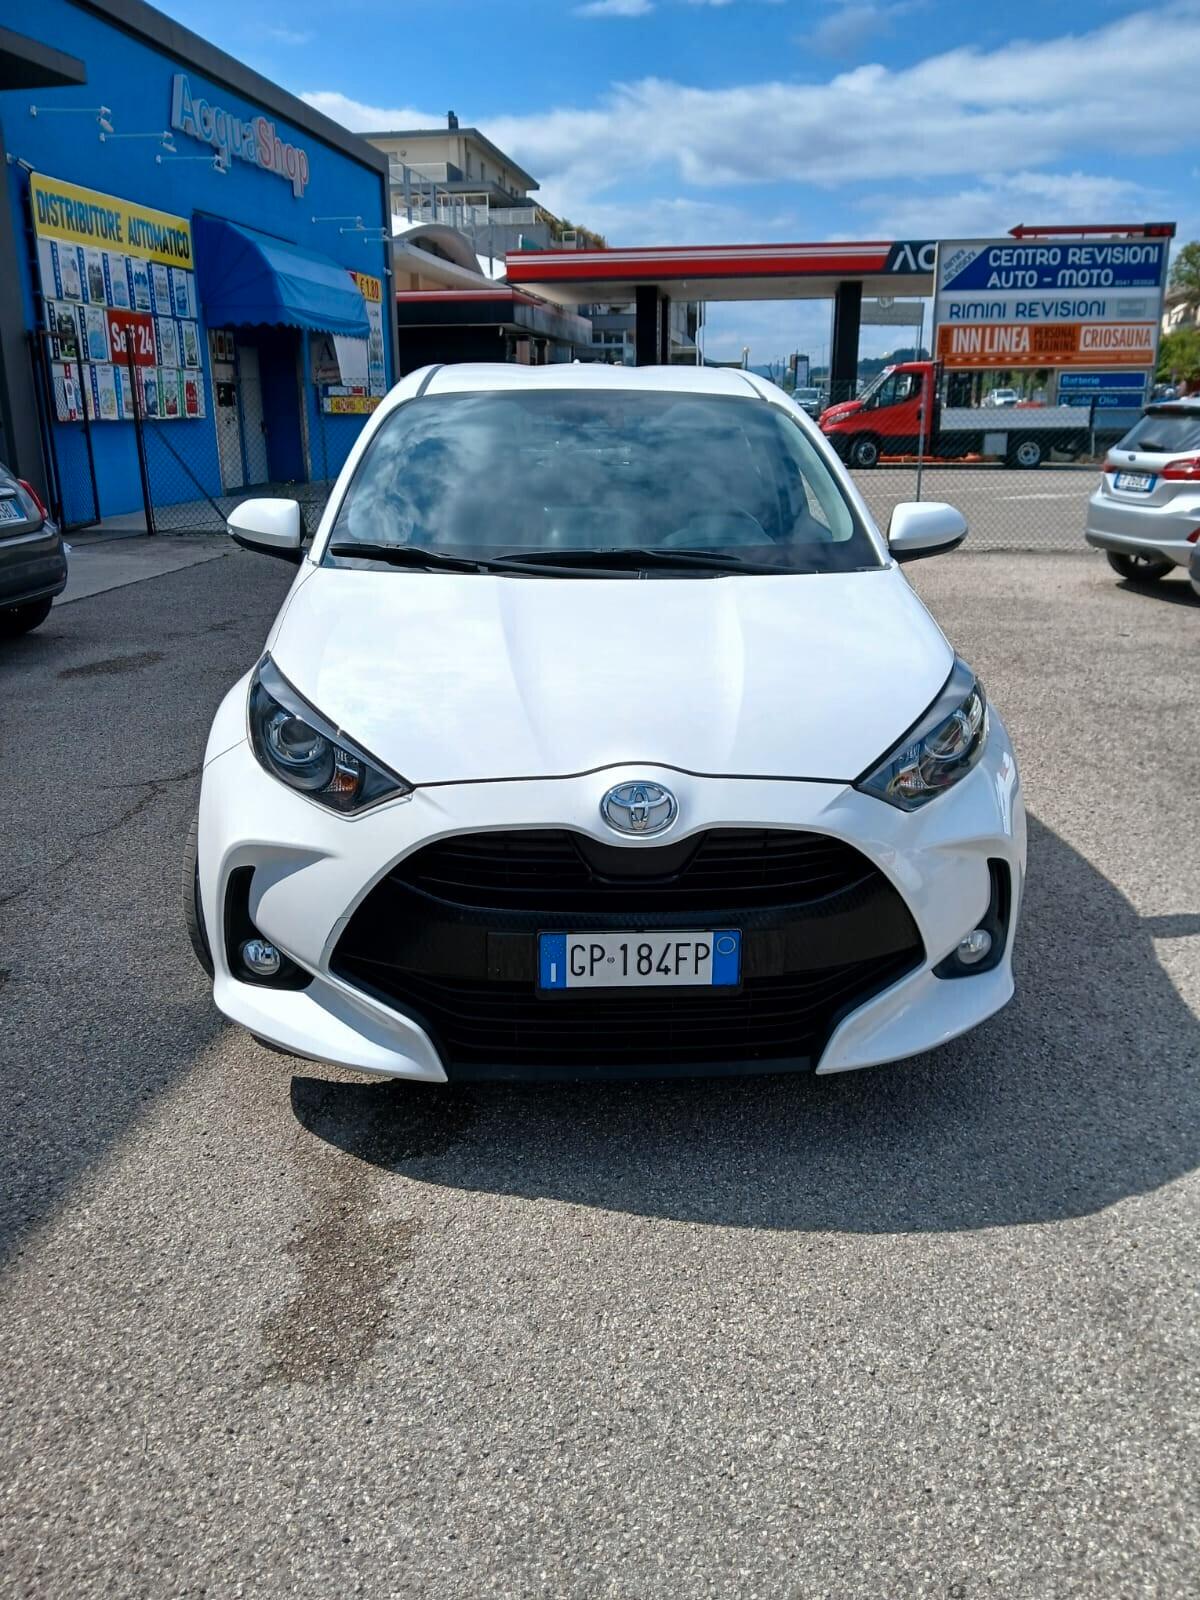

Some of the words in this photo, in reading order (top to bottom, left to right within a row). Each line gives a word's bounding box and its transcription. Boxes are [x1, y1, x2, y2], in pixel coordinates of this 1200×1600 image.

[172, 74, 309, 198] AcquaShop
[36, 190, 123, 242] DISTRIBUTORE
[128, 216, 190, 260] AUTOMATICO
[988, 248, 1061, 267] CENTRO
[1067, 246, 1159, 265] REVISIONI
[986, 270, 1038, 288] AUTO
[1057, 268, 1114, 286] MOTO
[949, 302, 1006, 319] RIMINI
[1015, 300, 1106, 317] REVISIONI
[138, 325, 153, 355] 24
[951, 327, 983, 353] INN
[984, 326, 1030, 353] LINEA
[1083, 328, 1152, 348] CRIOSAUNA
